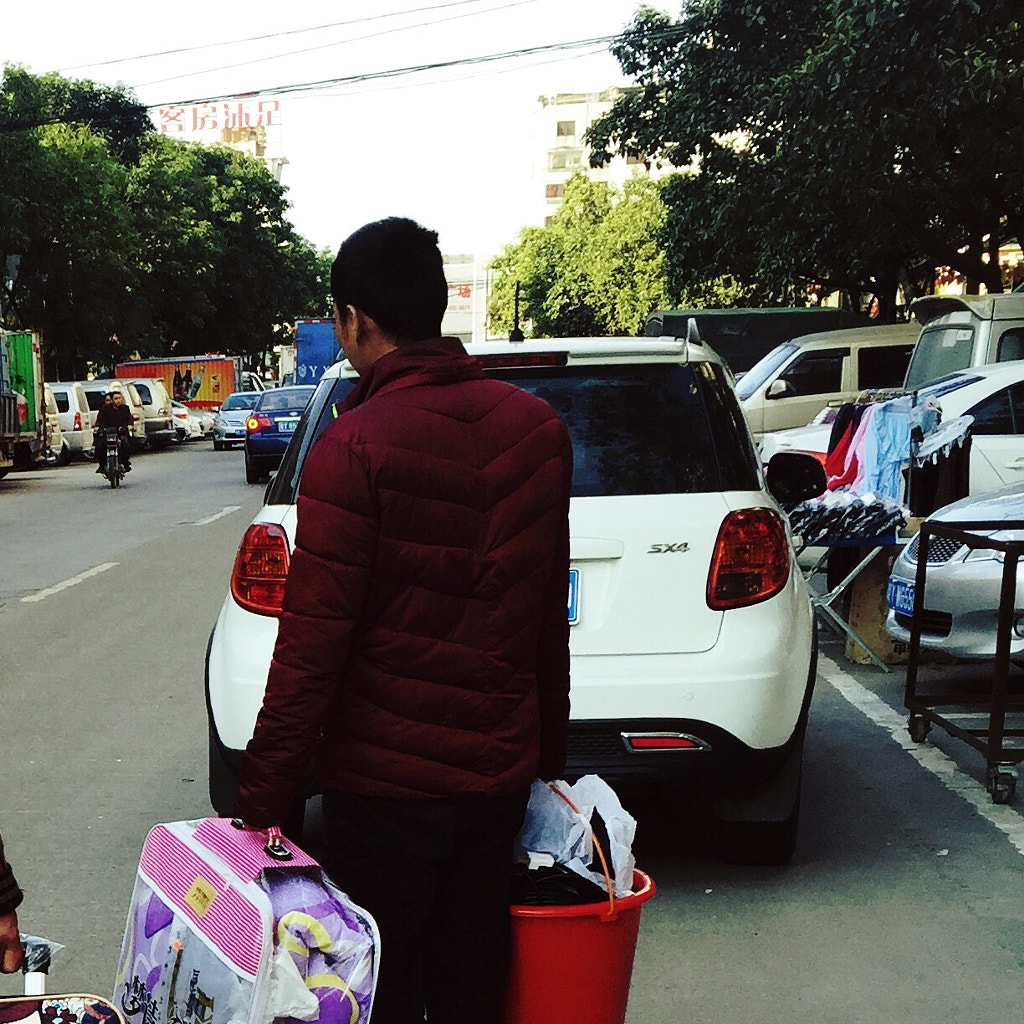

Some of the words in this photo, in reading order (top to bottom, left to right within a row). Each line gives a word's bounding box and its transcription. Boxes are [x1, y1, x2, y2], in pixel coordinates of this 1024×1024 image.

[158, 100, 282, 133] 客房沐足
[647, 542, 690, 554] SX4
